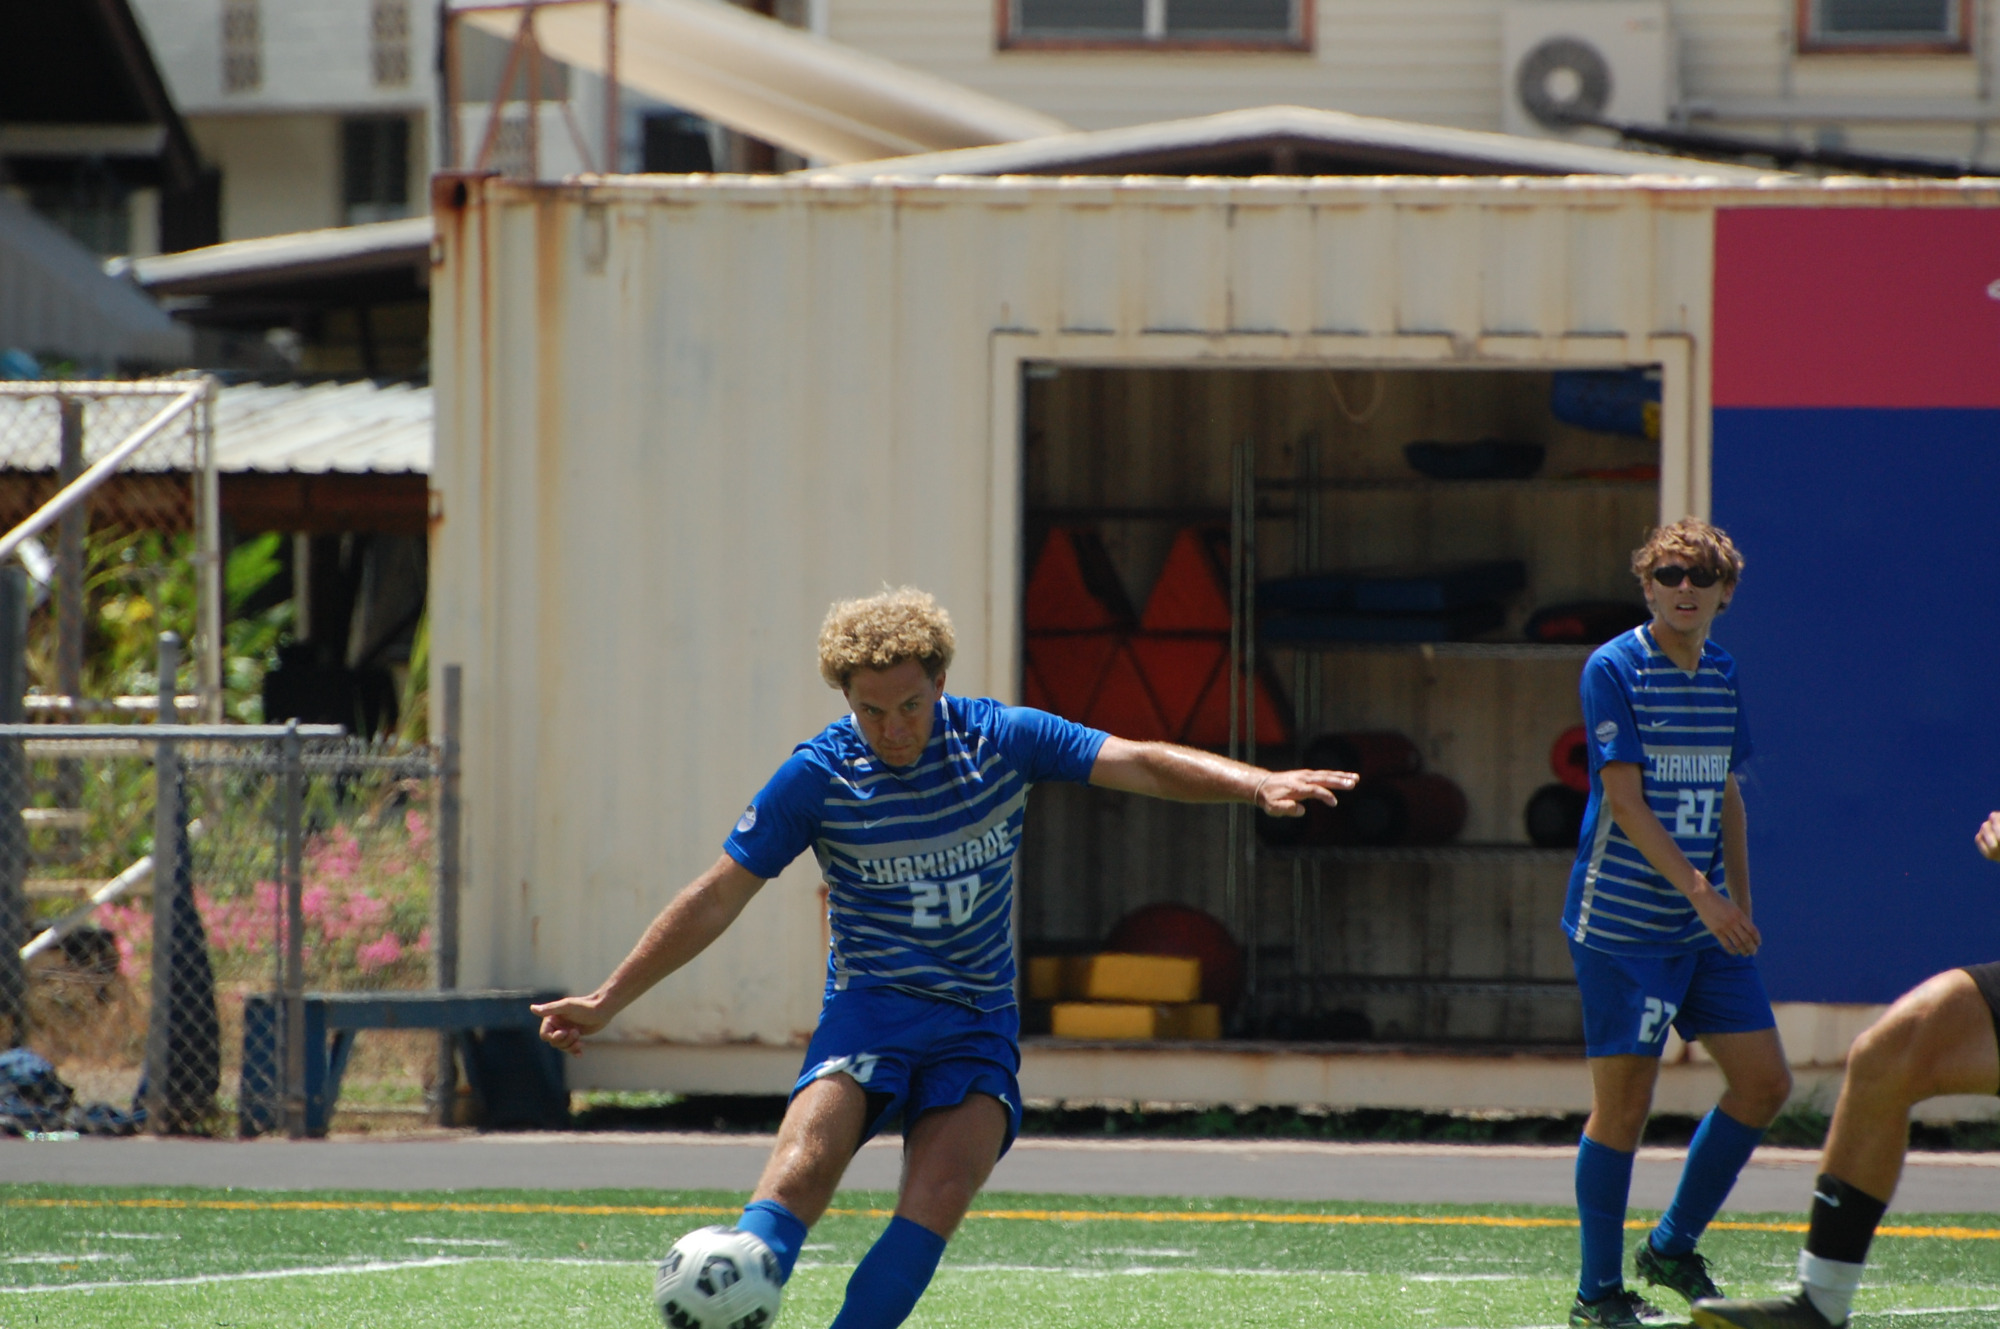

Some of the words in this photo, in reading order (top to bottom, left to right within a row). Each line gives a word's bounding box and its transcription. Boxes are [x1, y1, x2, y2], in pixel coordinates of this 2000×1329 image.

[1676, 788, 1716, 834] 27
[909, 874, 980, 929] 20
[1638, 996, 1678, 1043] 27
